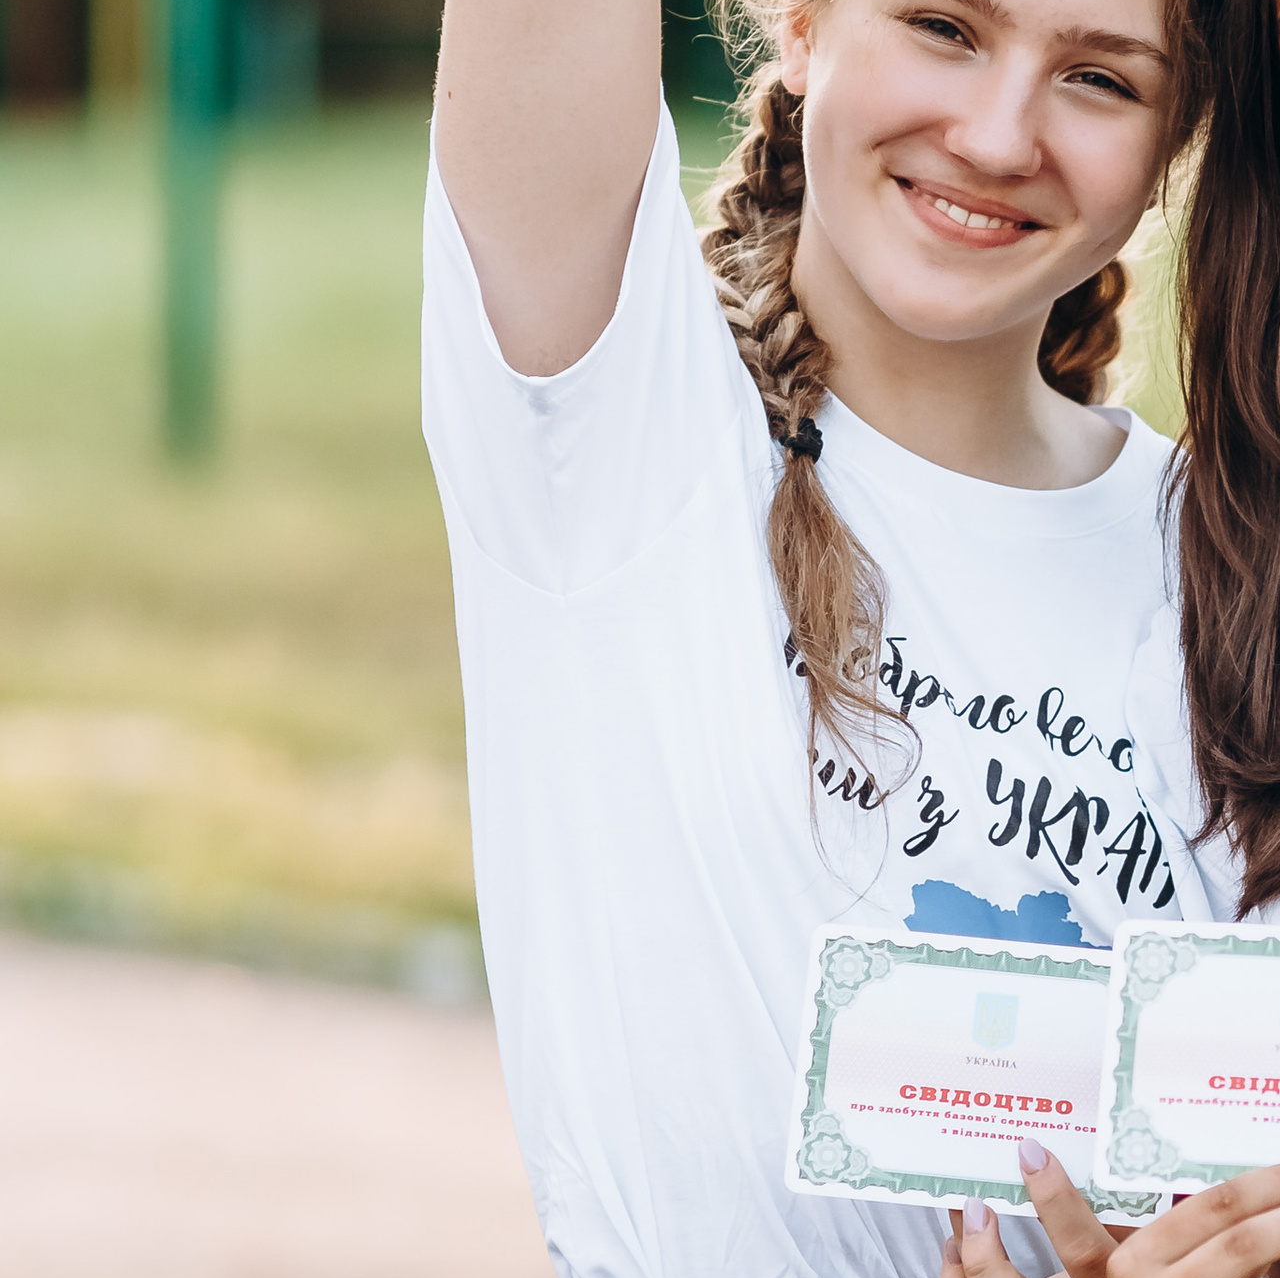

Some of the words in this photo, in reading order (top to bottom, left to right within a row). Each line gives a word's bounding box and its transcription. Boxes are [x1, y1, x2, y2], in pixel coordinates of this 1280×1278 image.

[902, 775, 960, 857] з
[965, 1056, 1018, 1069] УКРАЇНА
[899, 1084, 1074, 1115] СВІДОЦТВО
[1158, 1096, 1184, 1106] про
[1187, 1096, 1250, 1108] здобуття
[850, 1102, 875, 1112] про
[878, 1105, 940, 1118] здобуття
[944, 1110, 997, 1123] базової
[1000, 1118, 1071, 1131] середньої
[951, 1128, 1025, 1142] відзнакою
